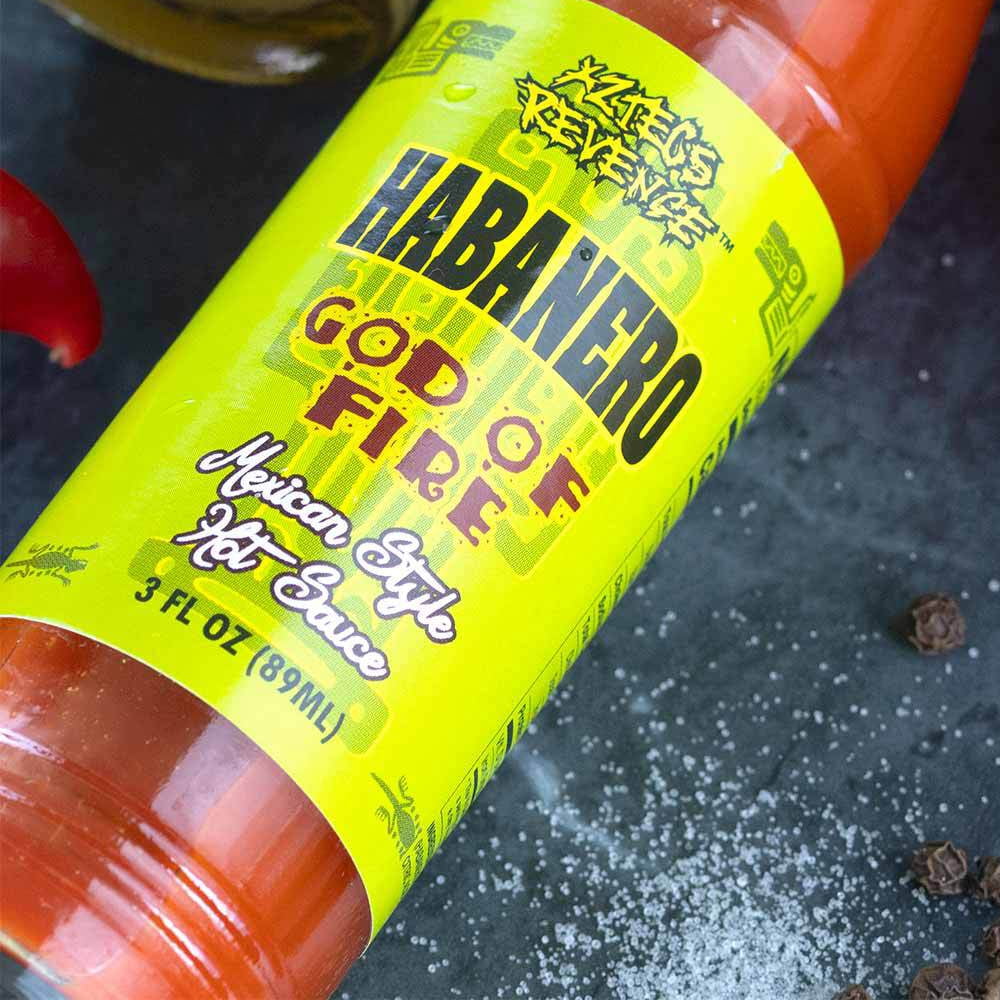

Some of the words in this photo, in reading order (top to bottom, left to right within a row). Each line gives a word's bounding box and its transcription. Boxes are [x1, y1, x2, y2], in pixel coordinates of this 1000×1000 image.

[514, 72, 720, 249] REVENGE
[336, 147, 702, 465] HABANERO
[304, 374, 507, 547] FIRE
[305, 296, 468, 407] GOD
[486, 416, 590, 518] OF
[170, 500, 302, 572] Hot
[270, 561, 390, 681] Sauce
[196, 431, 352, 549] Mexican
[352, 527, 461, 643] Style
[134, 577, 161, 603] 3
[160, 589, 199, 625] FL
[202, 613, 253, 656] OZ
[246, 645, 346, 744] (89ML)
